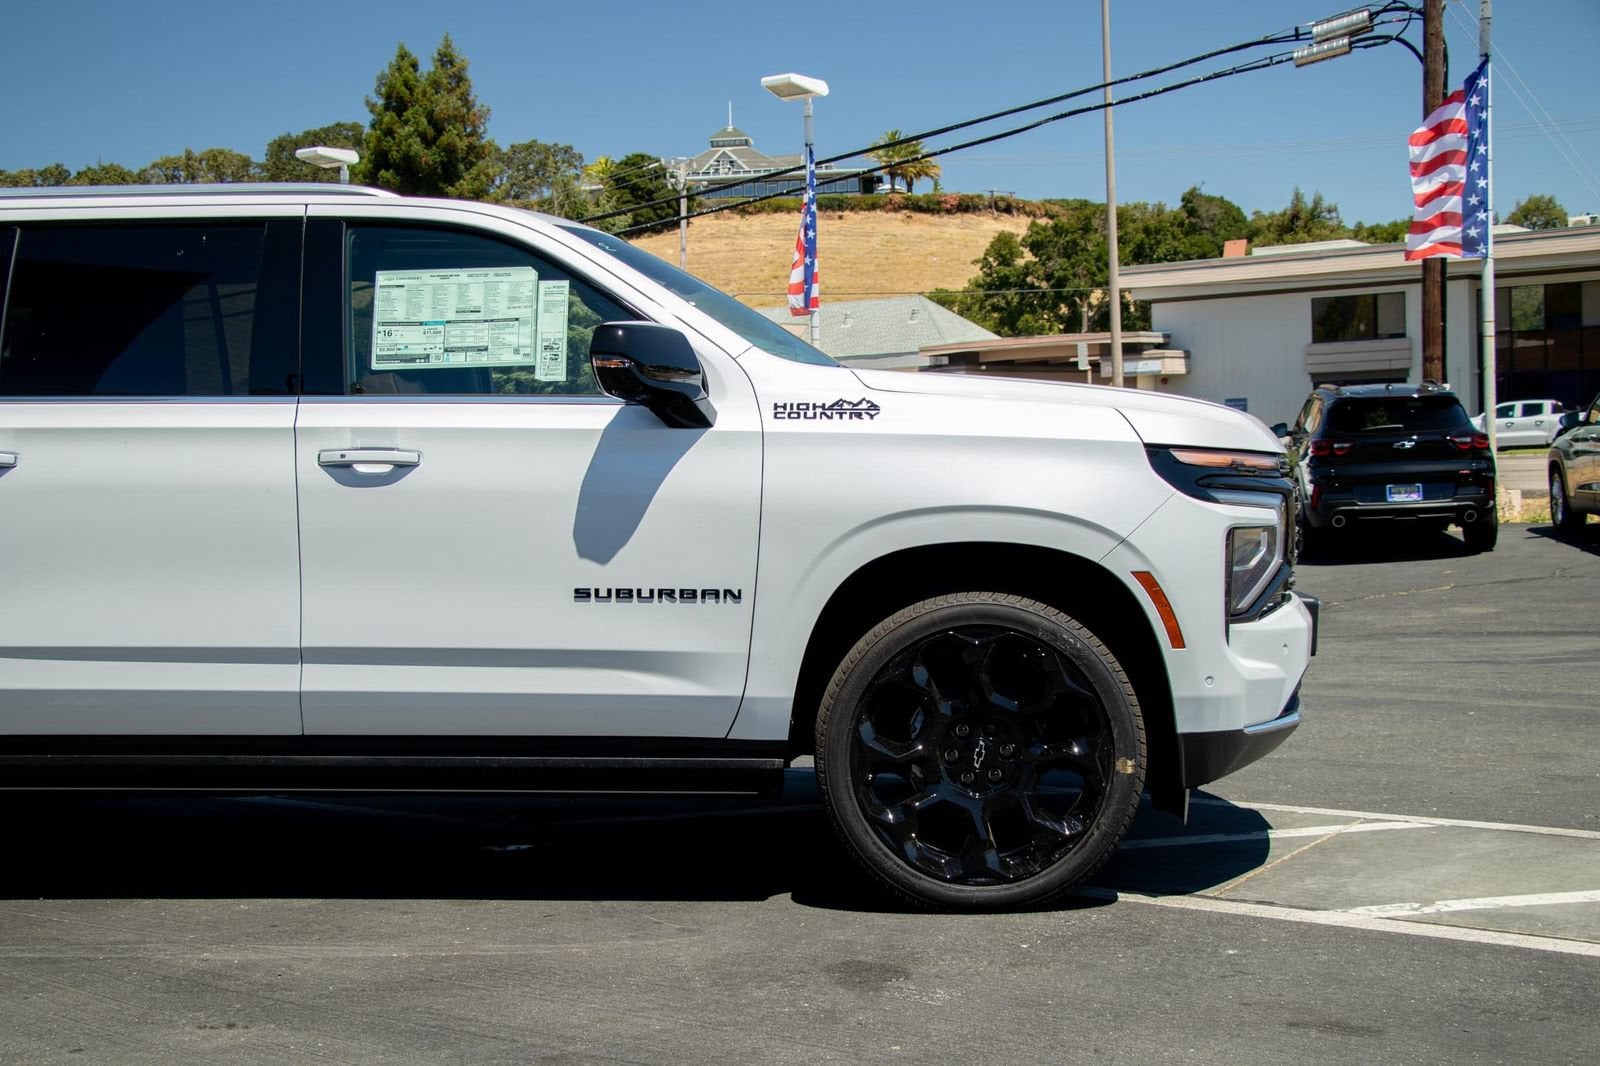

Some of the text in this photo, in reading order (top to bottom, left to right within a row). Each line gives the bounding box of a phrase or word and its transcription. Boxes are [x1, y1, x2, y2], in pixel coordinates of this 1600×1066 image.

[382, 329, 393, 337] 16
[773, 402, 827, 412] HIGH
[773, 411, 880, 420] COUNTRY
[573, 588, 742, 604] SUBURBAN
